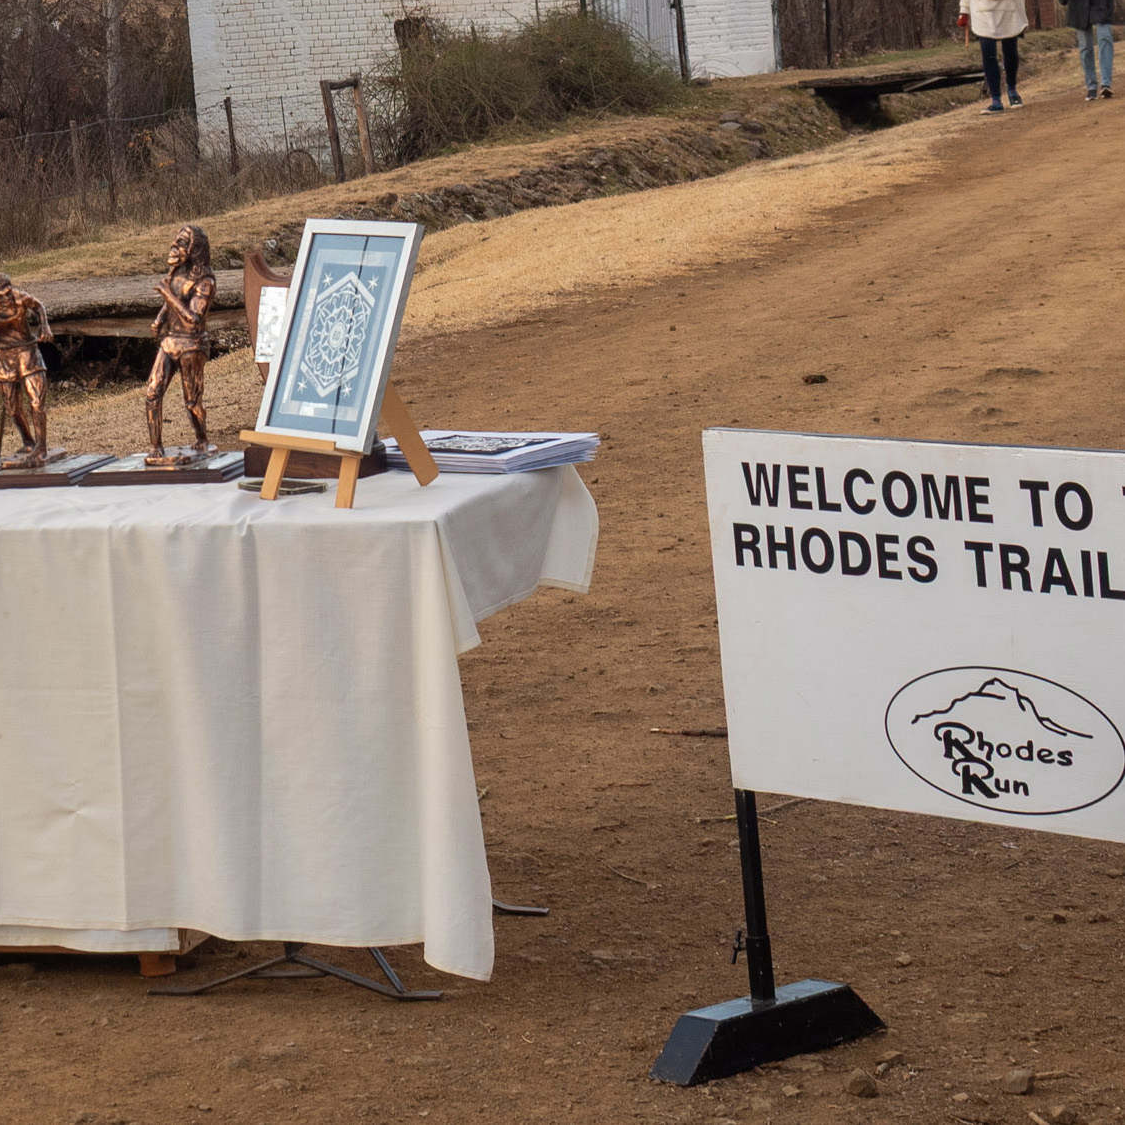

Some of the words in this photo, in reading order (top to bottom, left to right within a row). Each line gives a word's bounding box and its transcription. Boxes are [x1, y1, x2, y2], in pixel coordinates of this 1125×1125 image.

[741, 461, 994, 523] WELCOME
[1019, 479, 1094, 531] TO
[732, 522, 938, 584] RHODES
[964, 540, 1125, 600] TRAIL
[934, 722, 1073, 767] Rhodes
[951, 757, 1029, 798] Run
